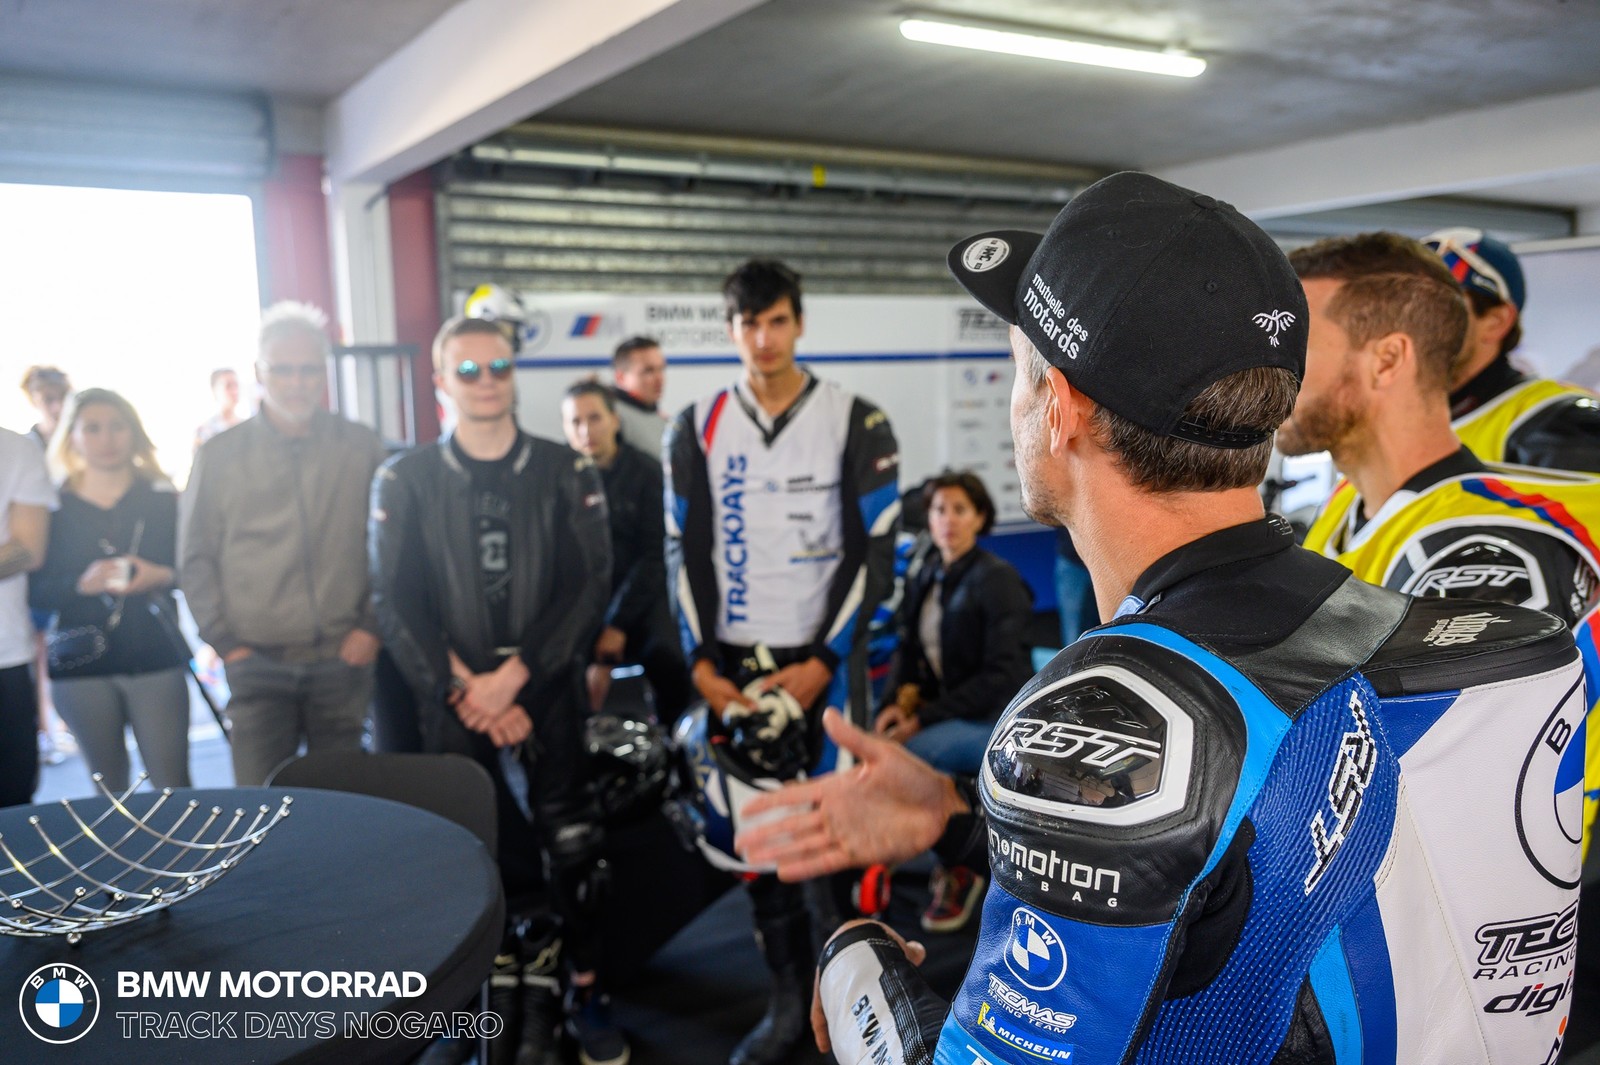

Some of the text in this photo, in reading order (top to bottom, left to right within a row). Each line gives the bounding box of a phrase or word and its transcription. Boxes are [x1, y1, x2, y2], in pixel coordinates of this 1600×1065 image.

[1023, 287, 1080, 360] motards
[1032, 273, 1089, 342] mutuelle des
[722, 452, 749, 626] TRACKDAYS
[991, 717, 1161, 769] RST
[1475, 899, 1579, 966] TEC
[987, 988, 1067, 1035] RACING TEAM
[1483, 969, 1575, 1017] digi
[997, 1026, 1072, 1059] MICHELIN
